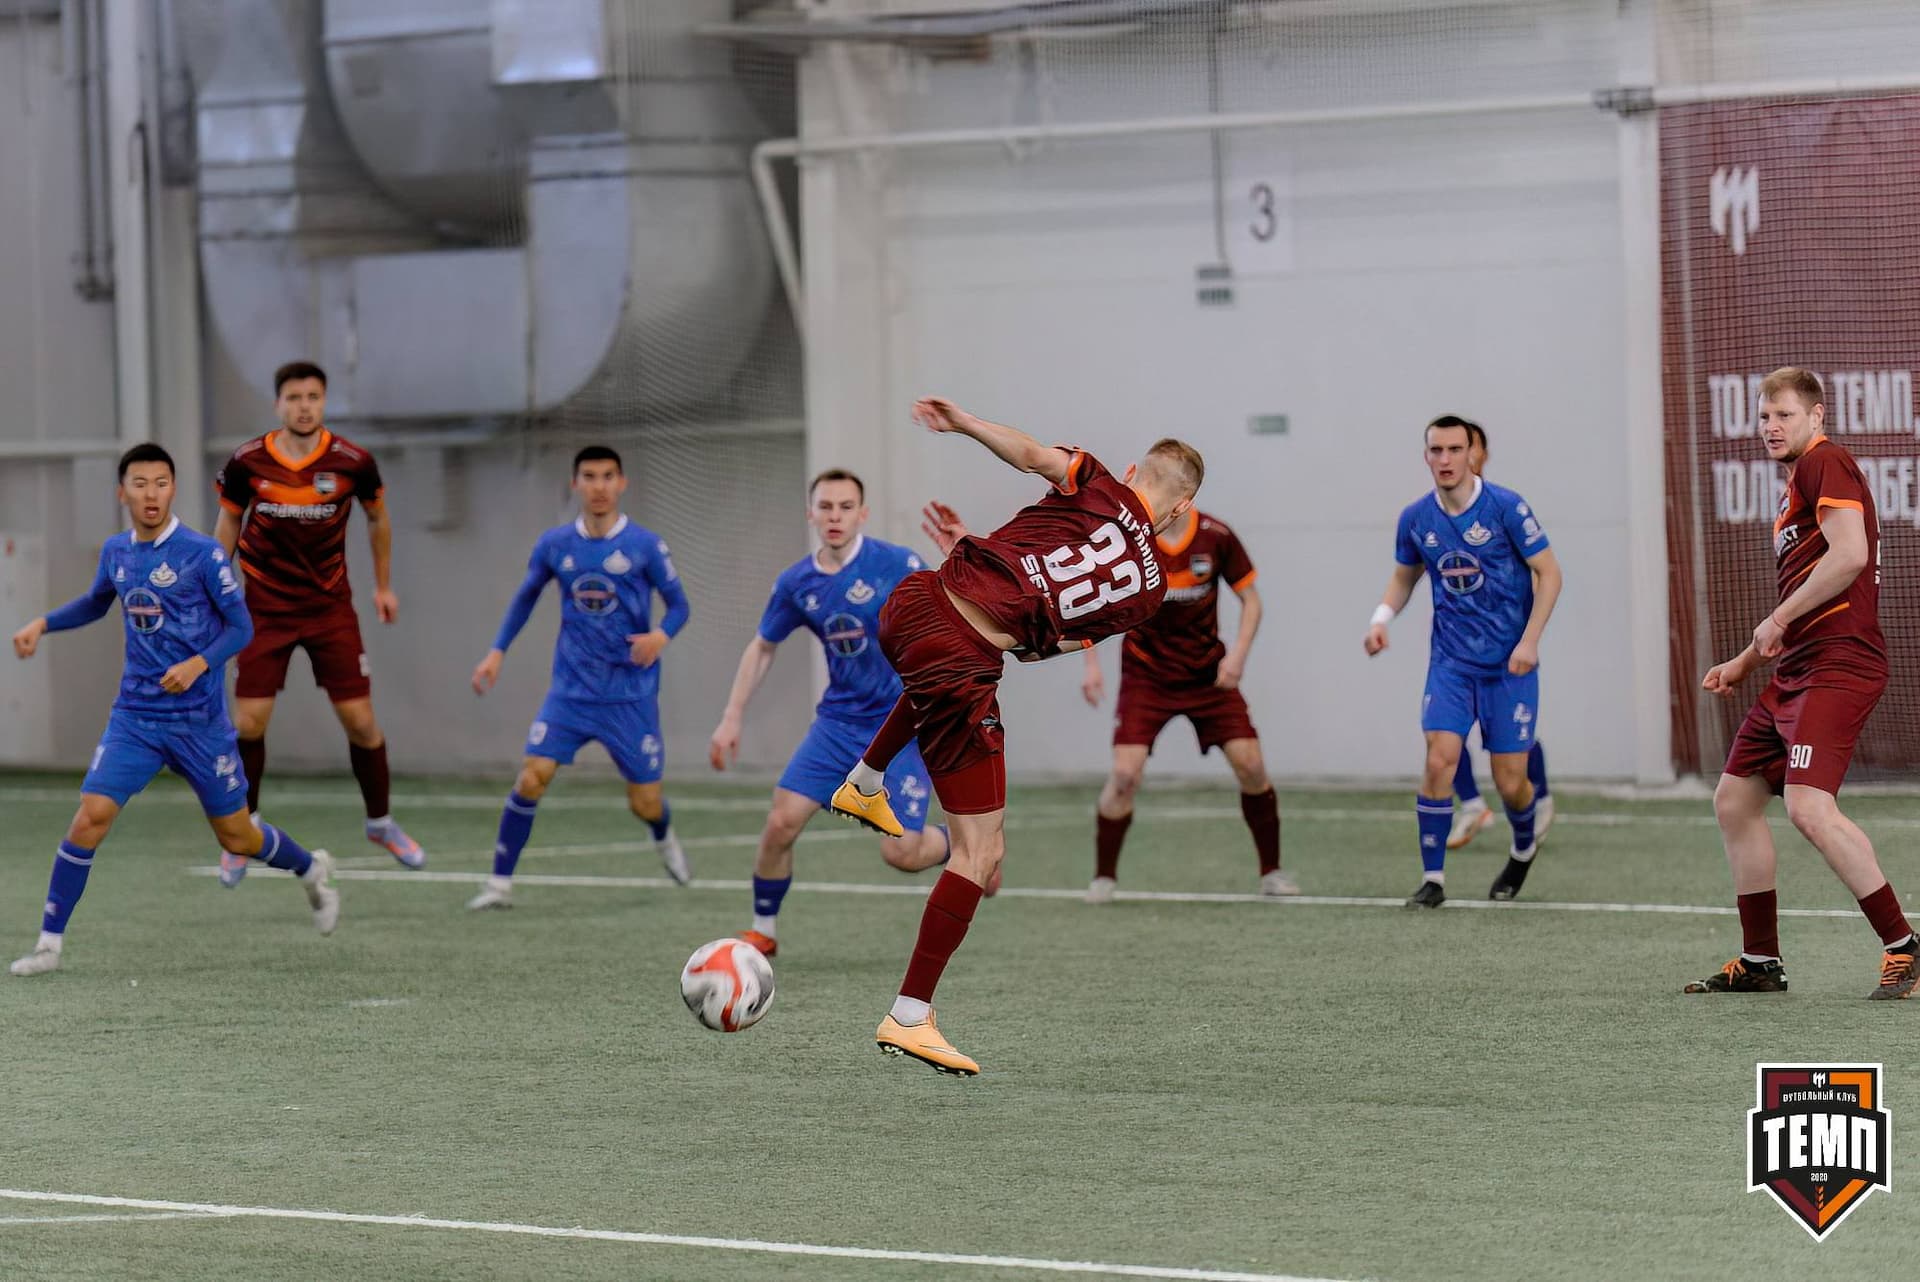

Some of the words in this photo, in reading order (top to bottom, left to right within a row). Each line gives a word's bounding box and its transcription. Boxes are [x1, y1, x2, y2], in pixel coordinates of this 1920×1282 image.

[1249, 182, 1278, 243] 3
[1043, 521, 1142, 620] 33
[1790, 745, 1814, 769] 90
